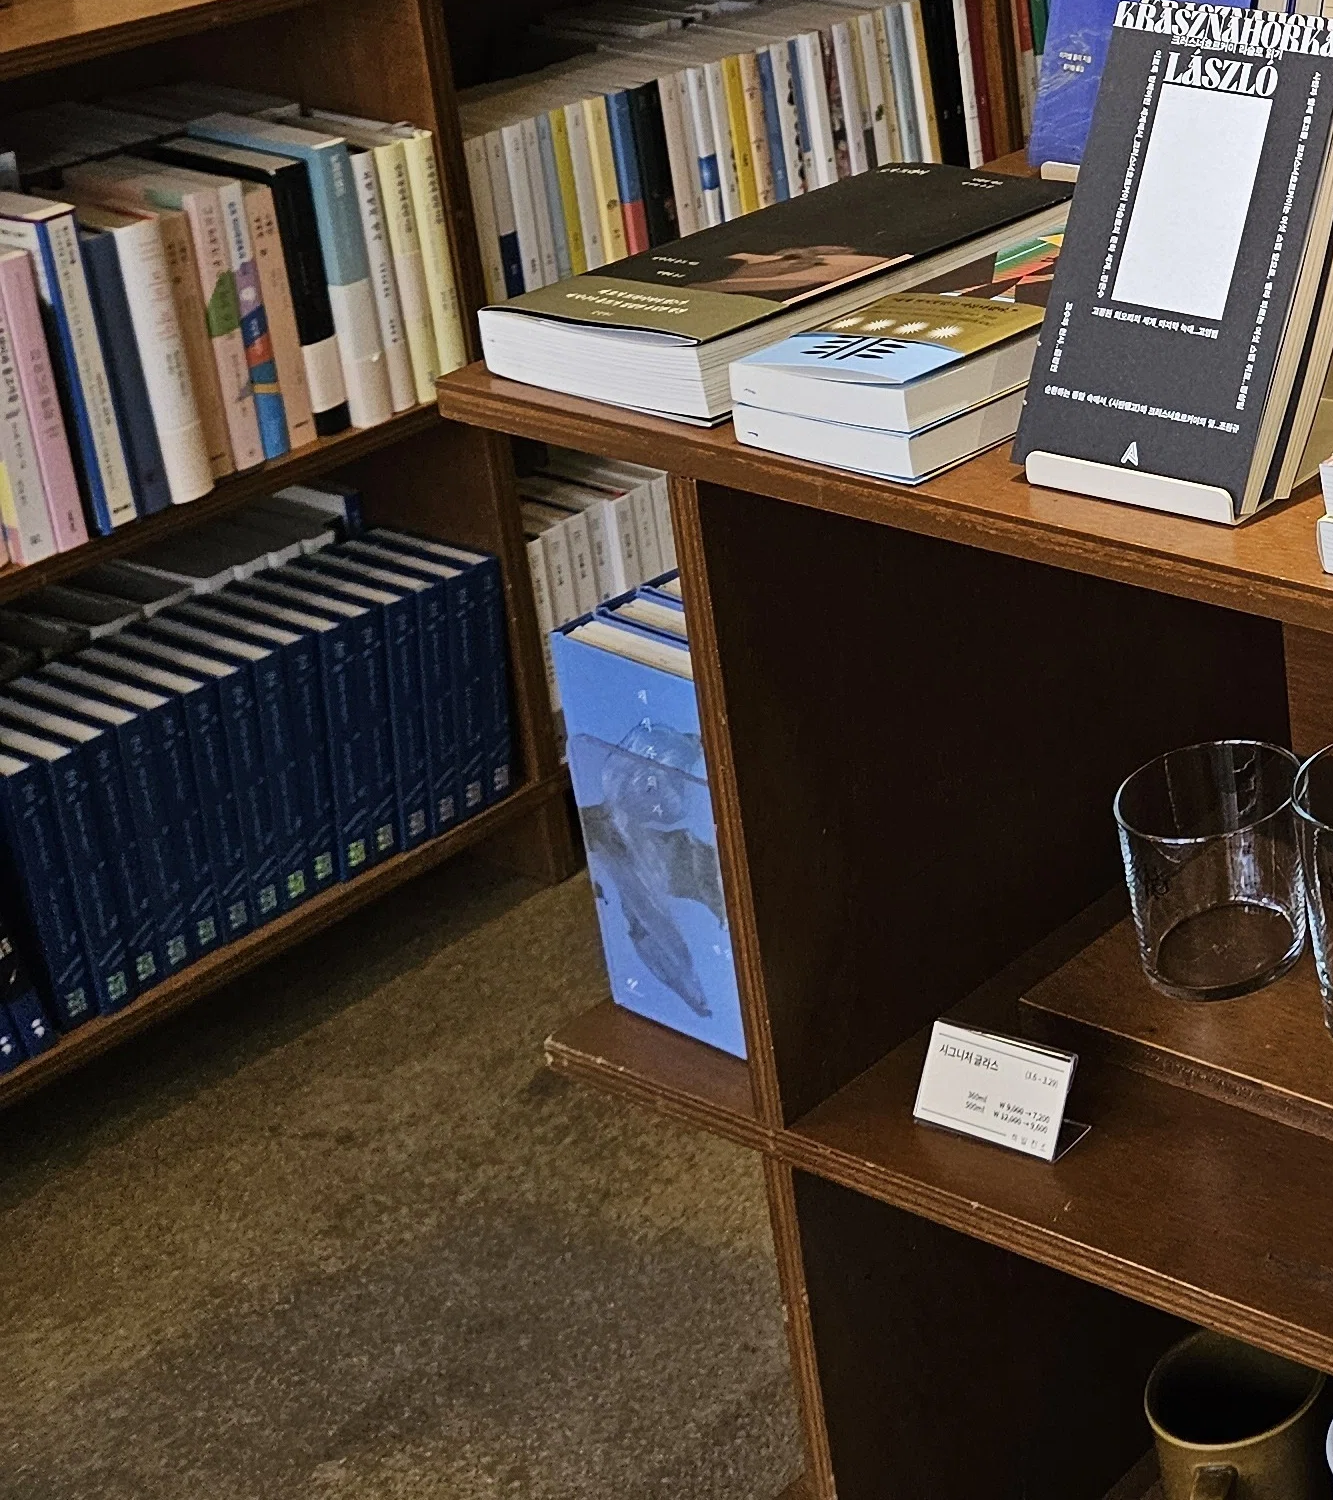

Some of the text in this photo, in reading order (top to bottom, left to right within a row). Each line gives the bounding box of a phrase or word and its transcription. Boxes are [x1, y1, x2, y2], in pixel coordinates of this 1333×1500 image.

[1163, 49, 1279, 97] LÁSZLÓ
[939, 1043, 999, 1072] 시그니처 글라스
